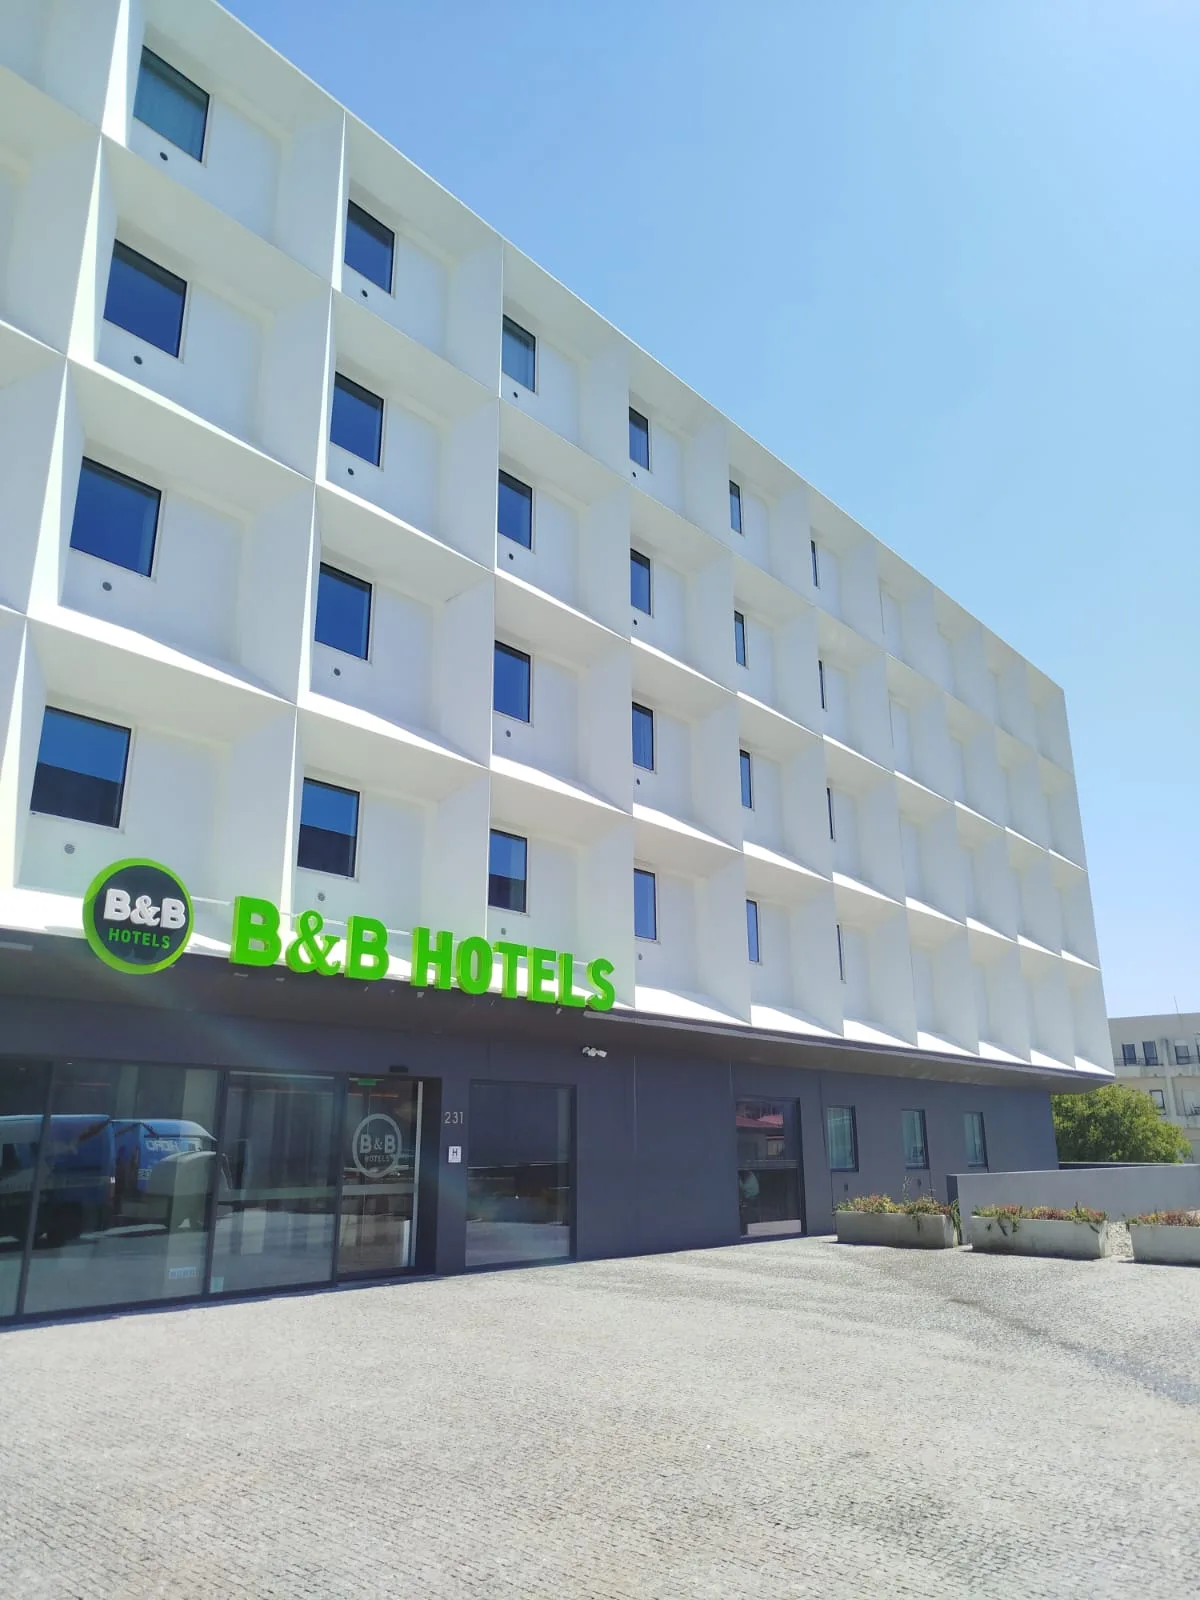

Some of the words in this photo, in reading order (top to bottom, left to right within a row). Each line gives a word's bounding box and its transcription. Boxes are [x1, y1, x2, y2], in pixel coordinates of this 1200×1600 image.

[103, 888, 186, 929] B&B
[108, 927, 171, 949] HOTELS
[230, 896, 390, 981] B&B
[410, 926, 615, 1011] HOTELS
[444, 1111, 464, 1124] 231
